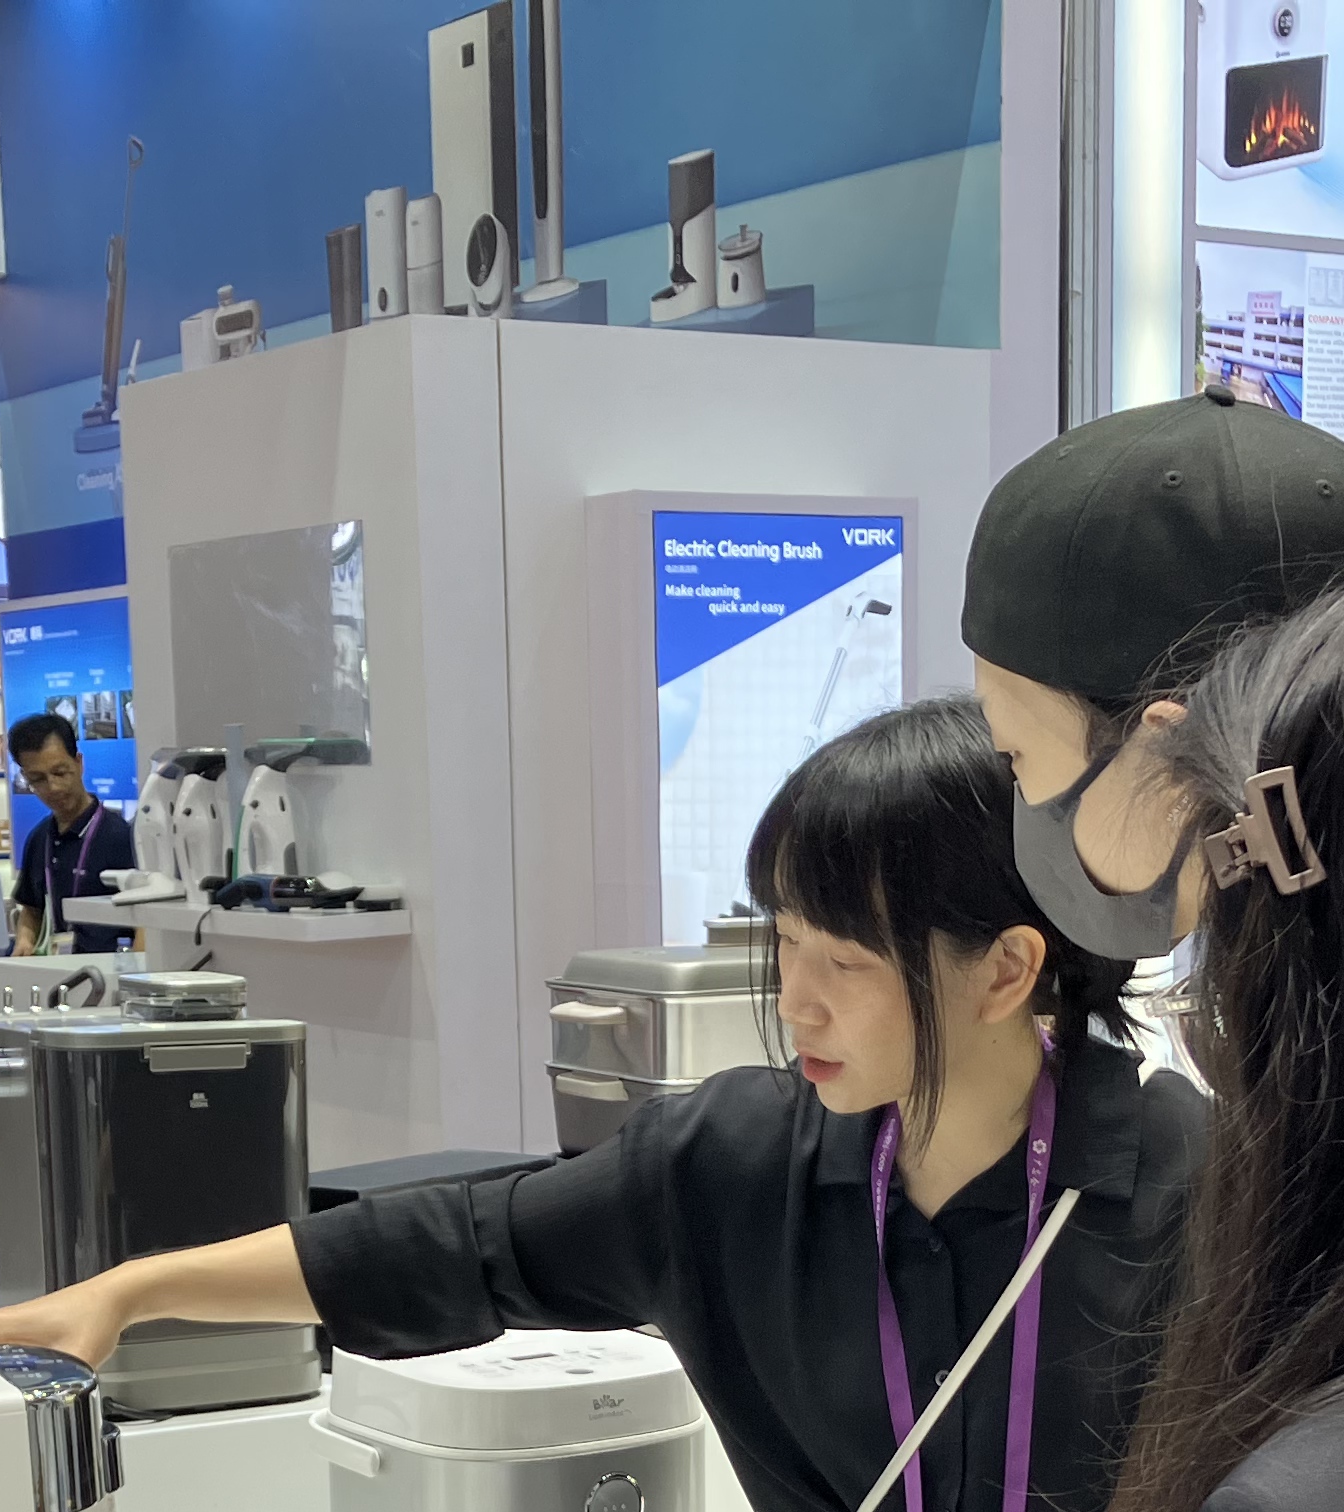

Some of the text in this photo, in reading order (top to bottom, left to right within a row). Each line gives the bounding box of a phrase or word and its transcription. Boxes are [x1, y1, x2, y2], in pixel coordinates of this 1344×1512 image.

[1307, 314, 1344, 325] COMPANY
[841, 527, 896, 546] VORK
[664, 539, 823, 563] Electric Cleaning Brush
[665, 584, 741, 599] Make cleaning
[708, 600, 785, 615] quick and easy
